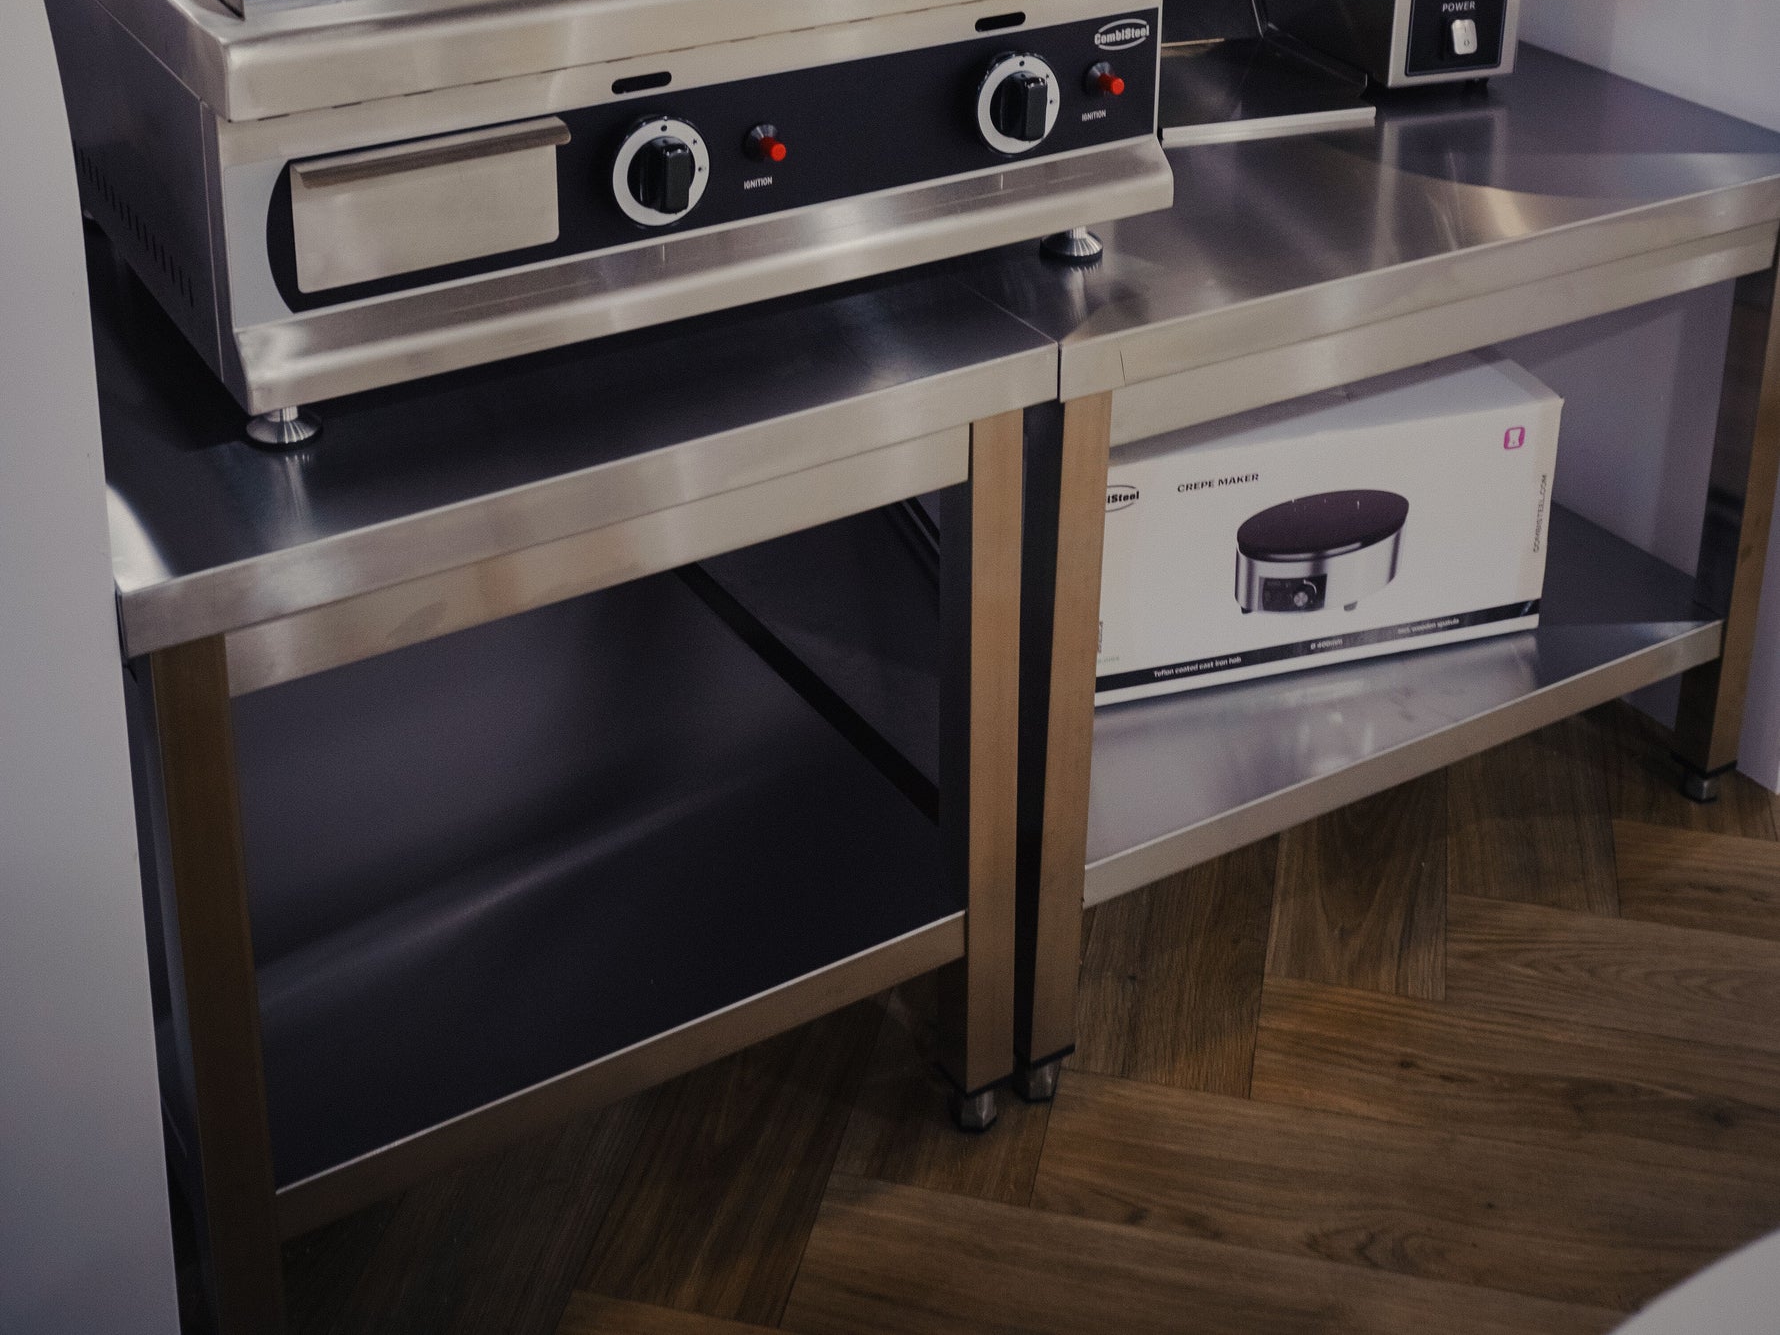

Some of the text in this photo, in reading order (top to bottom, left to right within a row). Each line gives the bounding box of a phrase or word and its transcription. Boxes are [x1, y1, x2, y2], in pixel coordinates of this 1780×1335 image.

[1442, 1, 1476, 12] POWER
[1094, 25, 1150, 45] CombiSteel
[1081, 109, 1107, 122] IGNITION
[743, 175, 773, 190] IGNITION
[1177, 473, 1259, 493] CREPE MAKER
[1533, 474, 1547, 553] COMBISTEEL.COM
[1175, 663, 1199, 675] coated
[1199, 661, 1214, 671] cast
